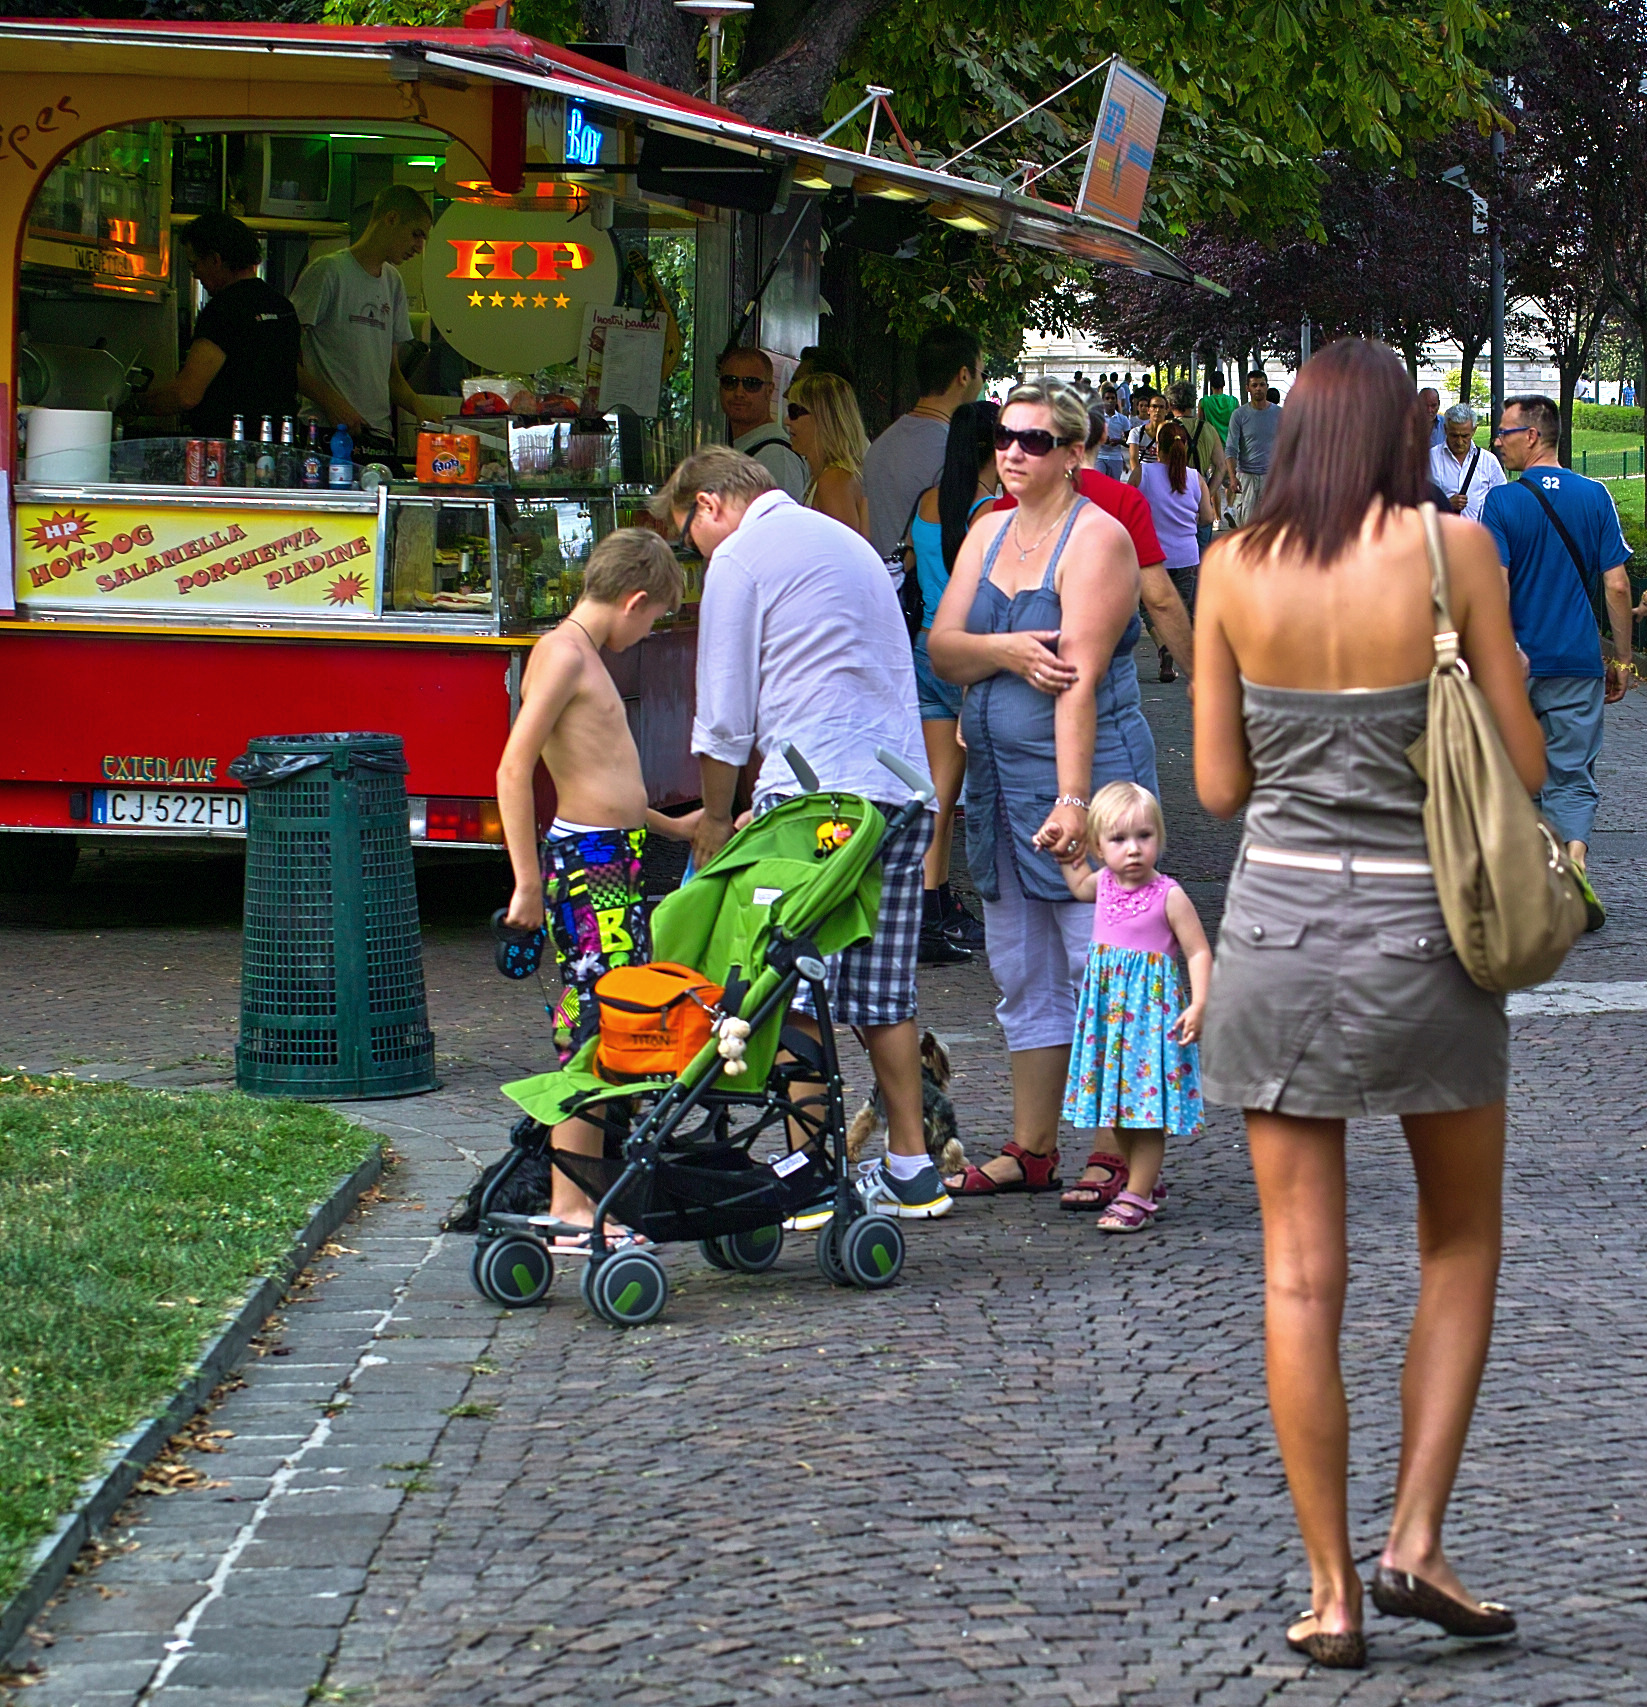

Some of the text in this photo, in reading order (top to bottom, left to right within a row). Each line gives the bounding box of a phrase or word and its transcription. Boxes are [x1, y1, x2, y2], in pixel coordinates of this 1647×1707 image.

[446, 240, 596, 280] HP
[597, 314, 624, 326] nostri
[624, 316, 661, 330] panini
[1542, 476, 1560, 490] 32
[45, 522, 78, 539] HP
[28, 524, 155, 588] HOT-DOG
[96, 524, 248, 592] SALAMELLA
[174, 527, 322, 595] PORCHETTA
[263, 536, 371, 590] PIADINE
[102, 755, 217, 782] EXTENSIVE
